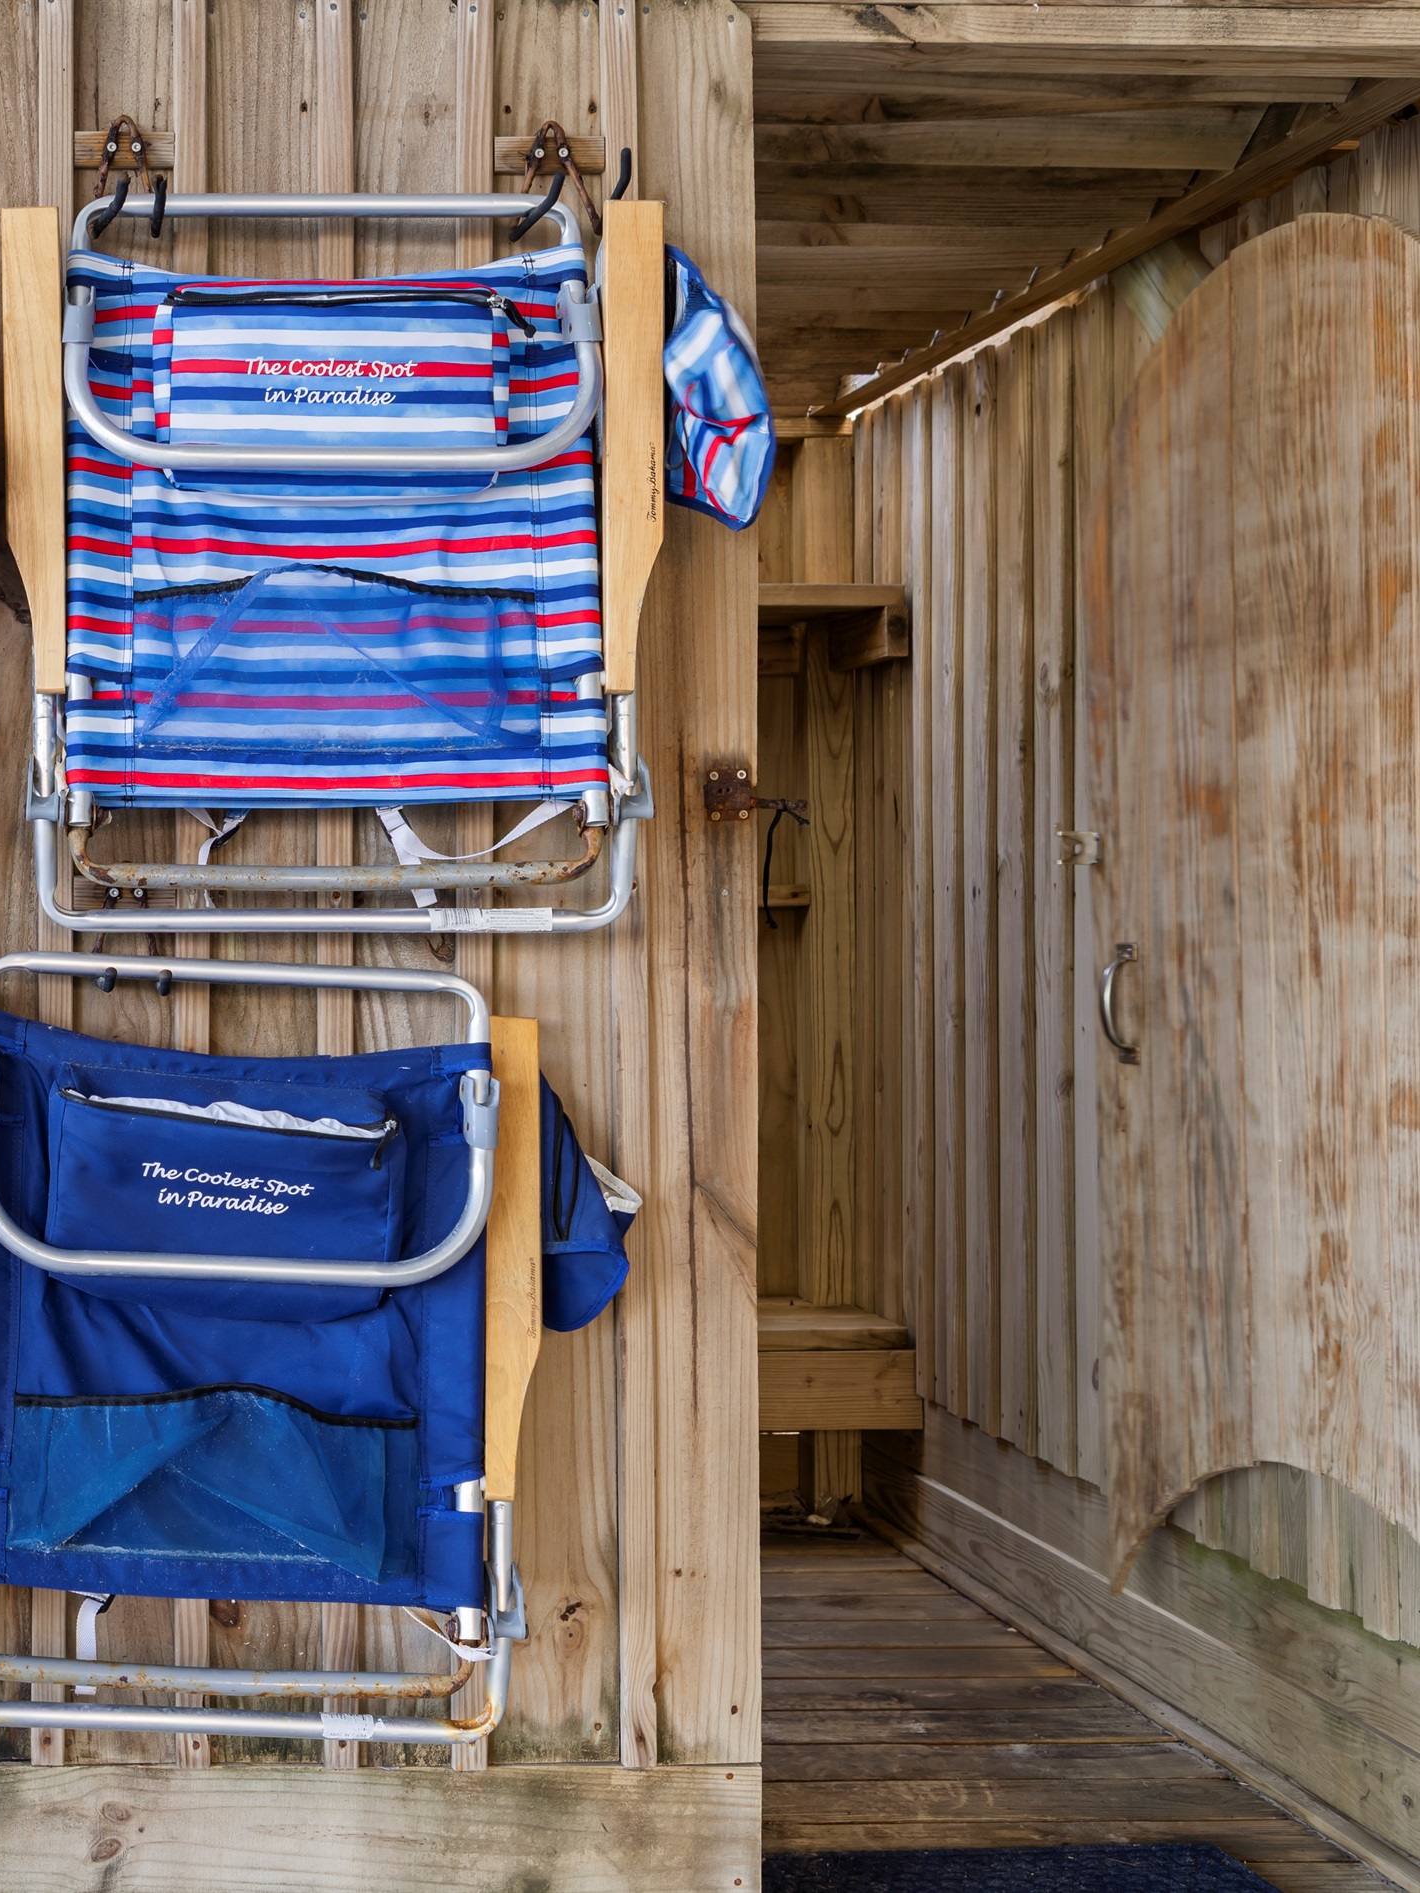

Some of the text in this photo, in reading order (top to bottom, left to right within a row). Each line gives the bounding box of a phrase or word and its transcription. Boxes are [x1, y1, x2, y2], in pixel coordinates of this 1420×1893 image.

[245, 356, 418, 383] The Coolest Spot
[264, 386, 396, 407] in Paradise
[646, 485, 660, 523] Tommy
[141, 1162, 315, 1197] The Coolest Spot
[157, 1188, 290, 1215] in Paradise
[526, 1300, 540, 1339] Tommy
